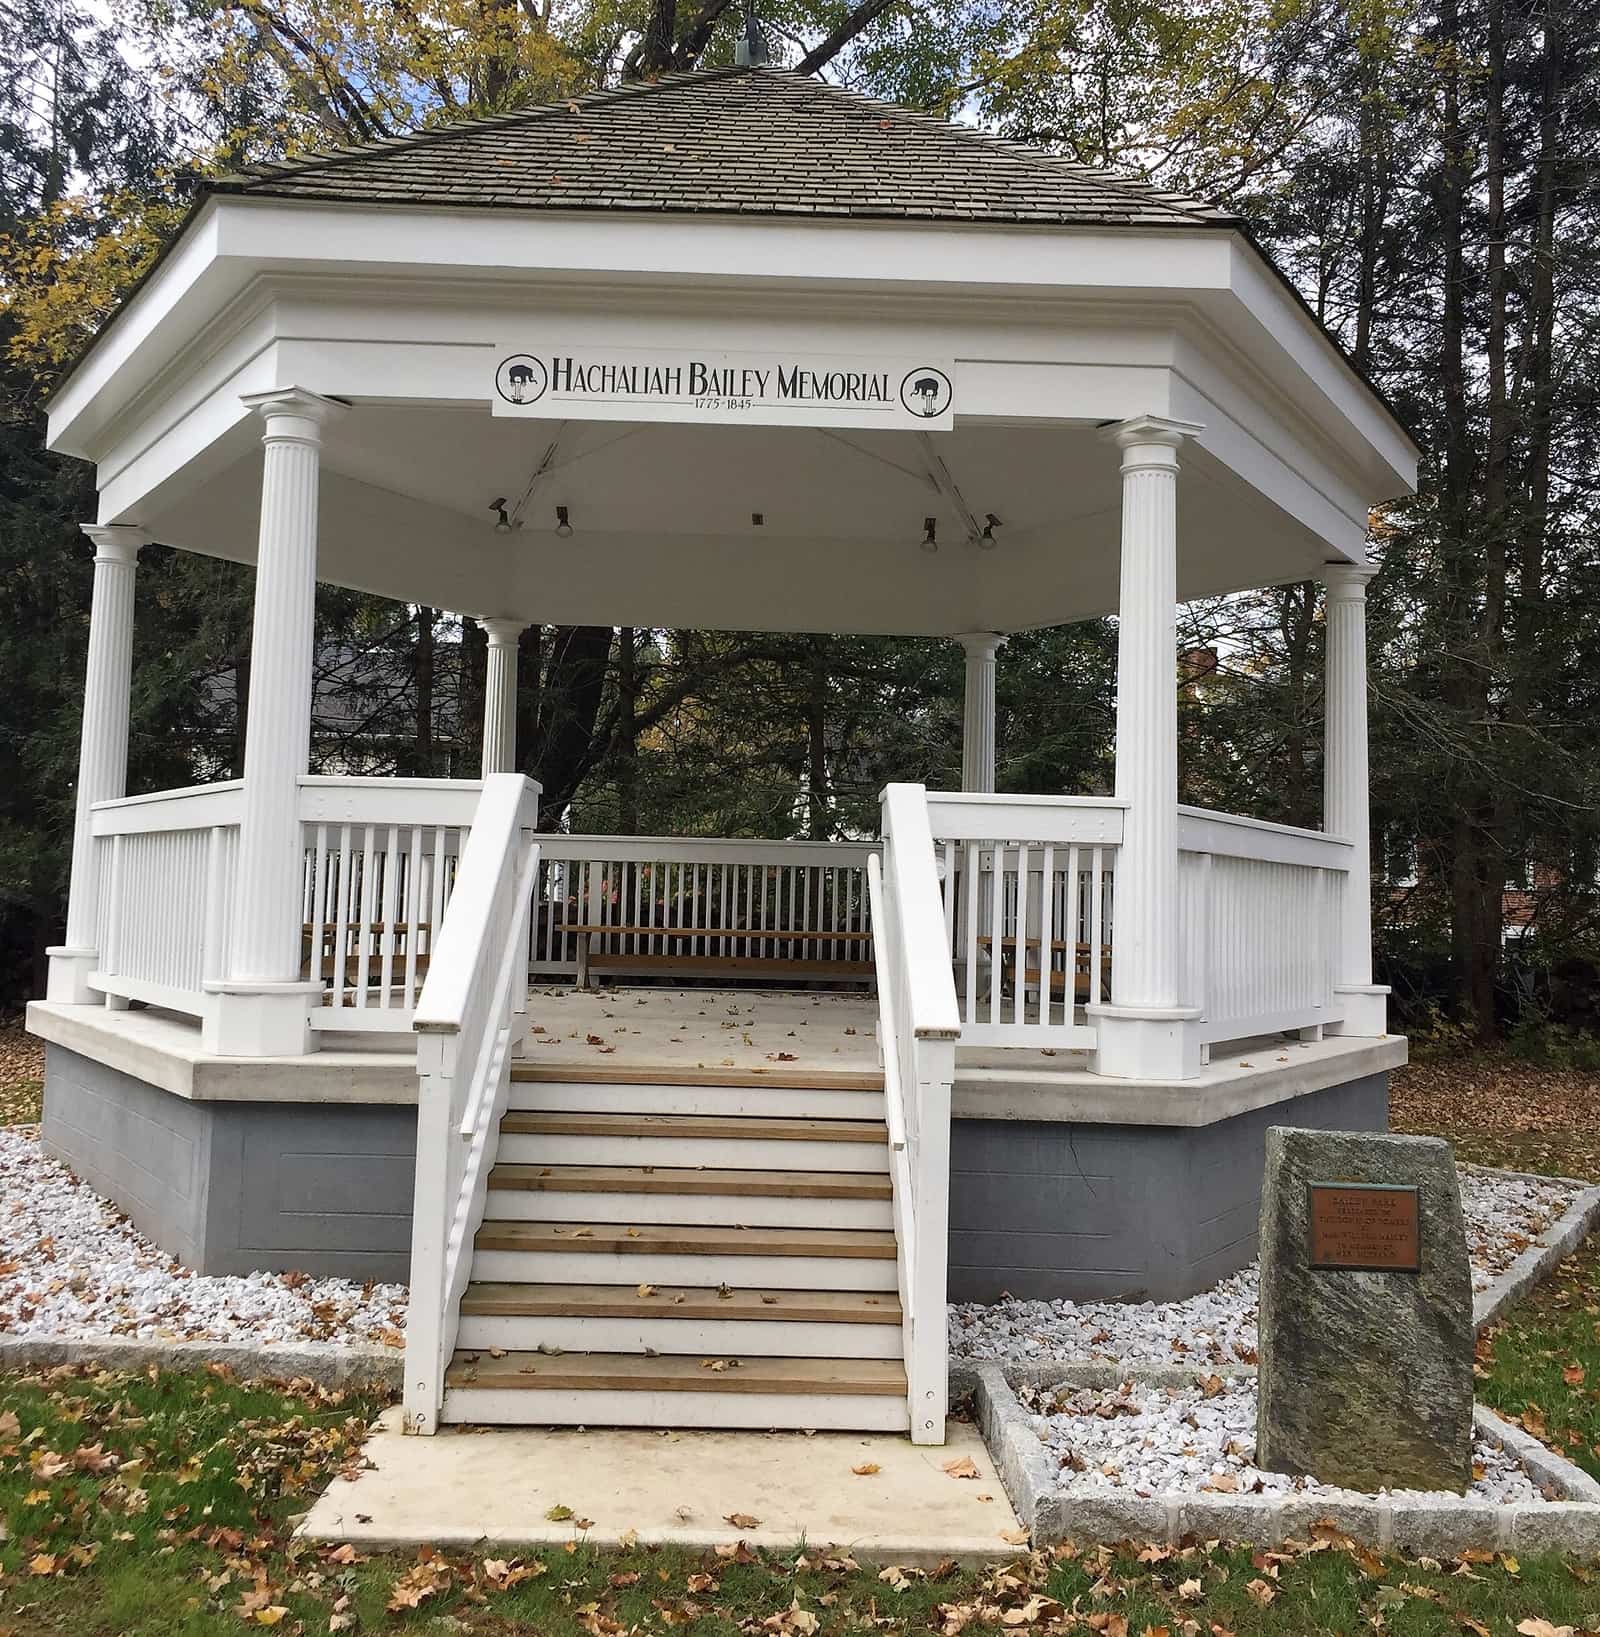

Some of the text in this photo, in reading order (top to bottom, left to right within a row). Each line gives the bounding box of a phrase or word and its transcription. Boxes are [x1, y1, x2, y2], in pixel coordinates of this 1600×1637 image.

[552, 357, 895, 402] HACHALIAH BAILEY MEMORIAL
